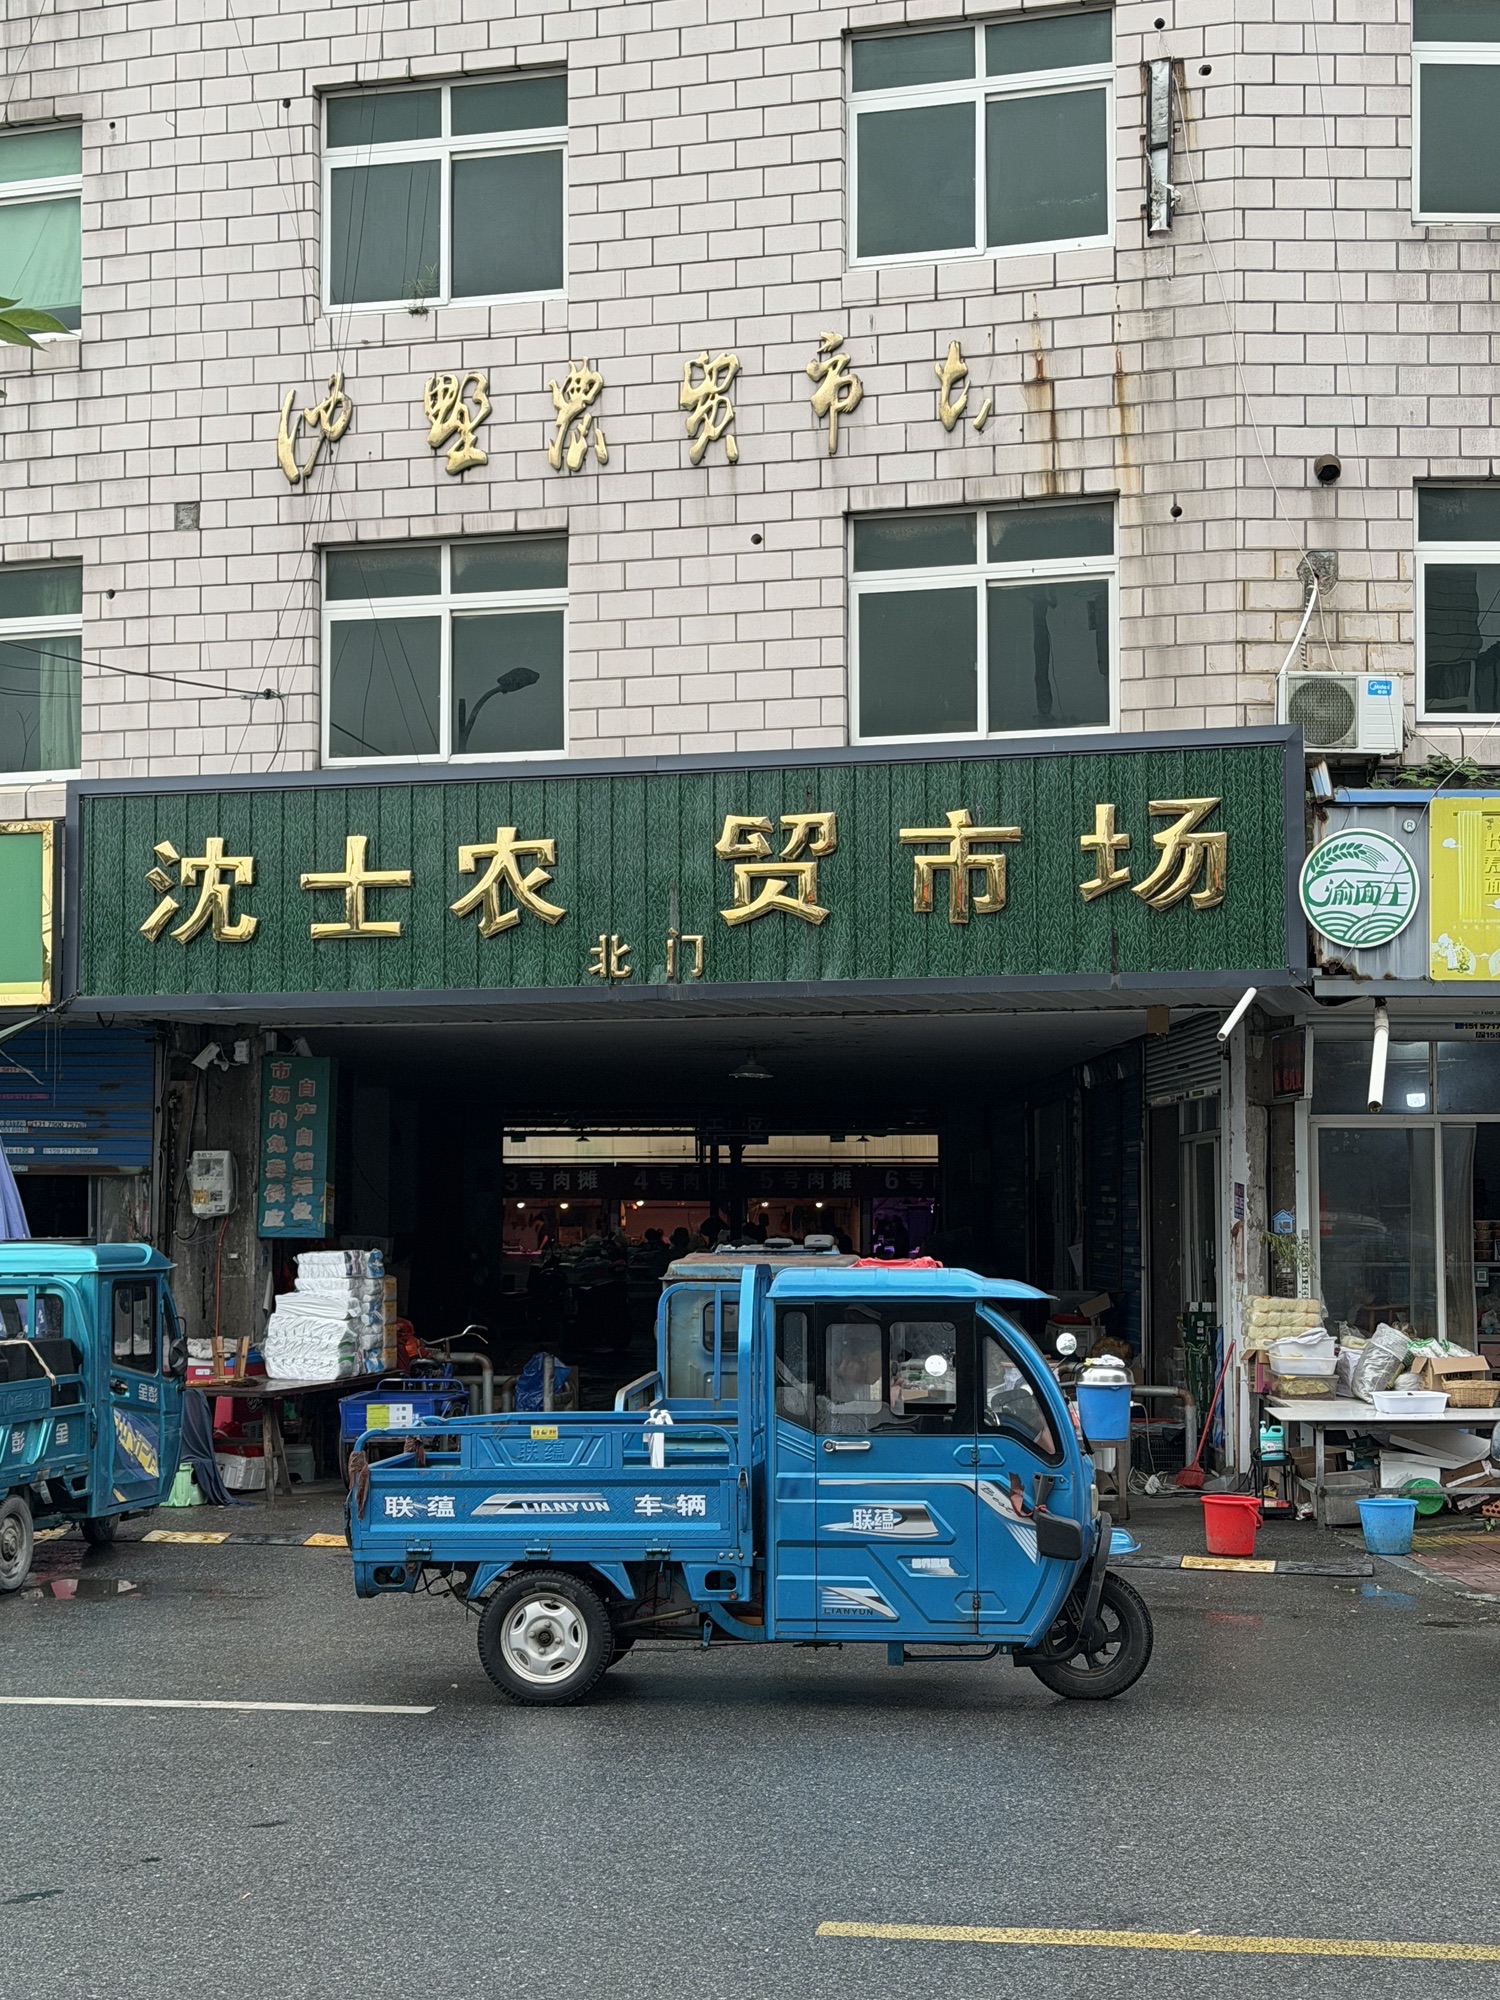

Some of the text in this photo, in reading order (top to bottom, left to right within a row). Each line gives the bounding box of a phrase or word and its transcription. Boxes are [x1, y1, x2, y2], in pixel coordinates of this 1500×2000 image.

[138, 797, 1228, 944] 沈士农贸市场
[1322, 878, 1410, 907] 渝面王
[588, 934, 704, 979] 北门
[384, 1496, 456, 1518] 联蕴
[521, 1502, 610, 1513] LIANYUN
[634, 1494, 706, 1516] 车辆
[852, 1508, 894, 1530] 联蕴
[822, 1607, 875, 1616] LIANYUN
